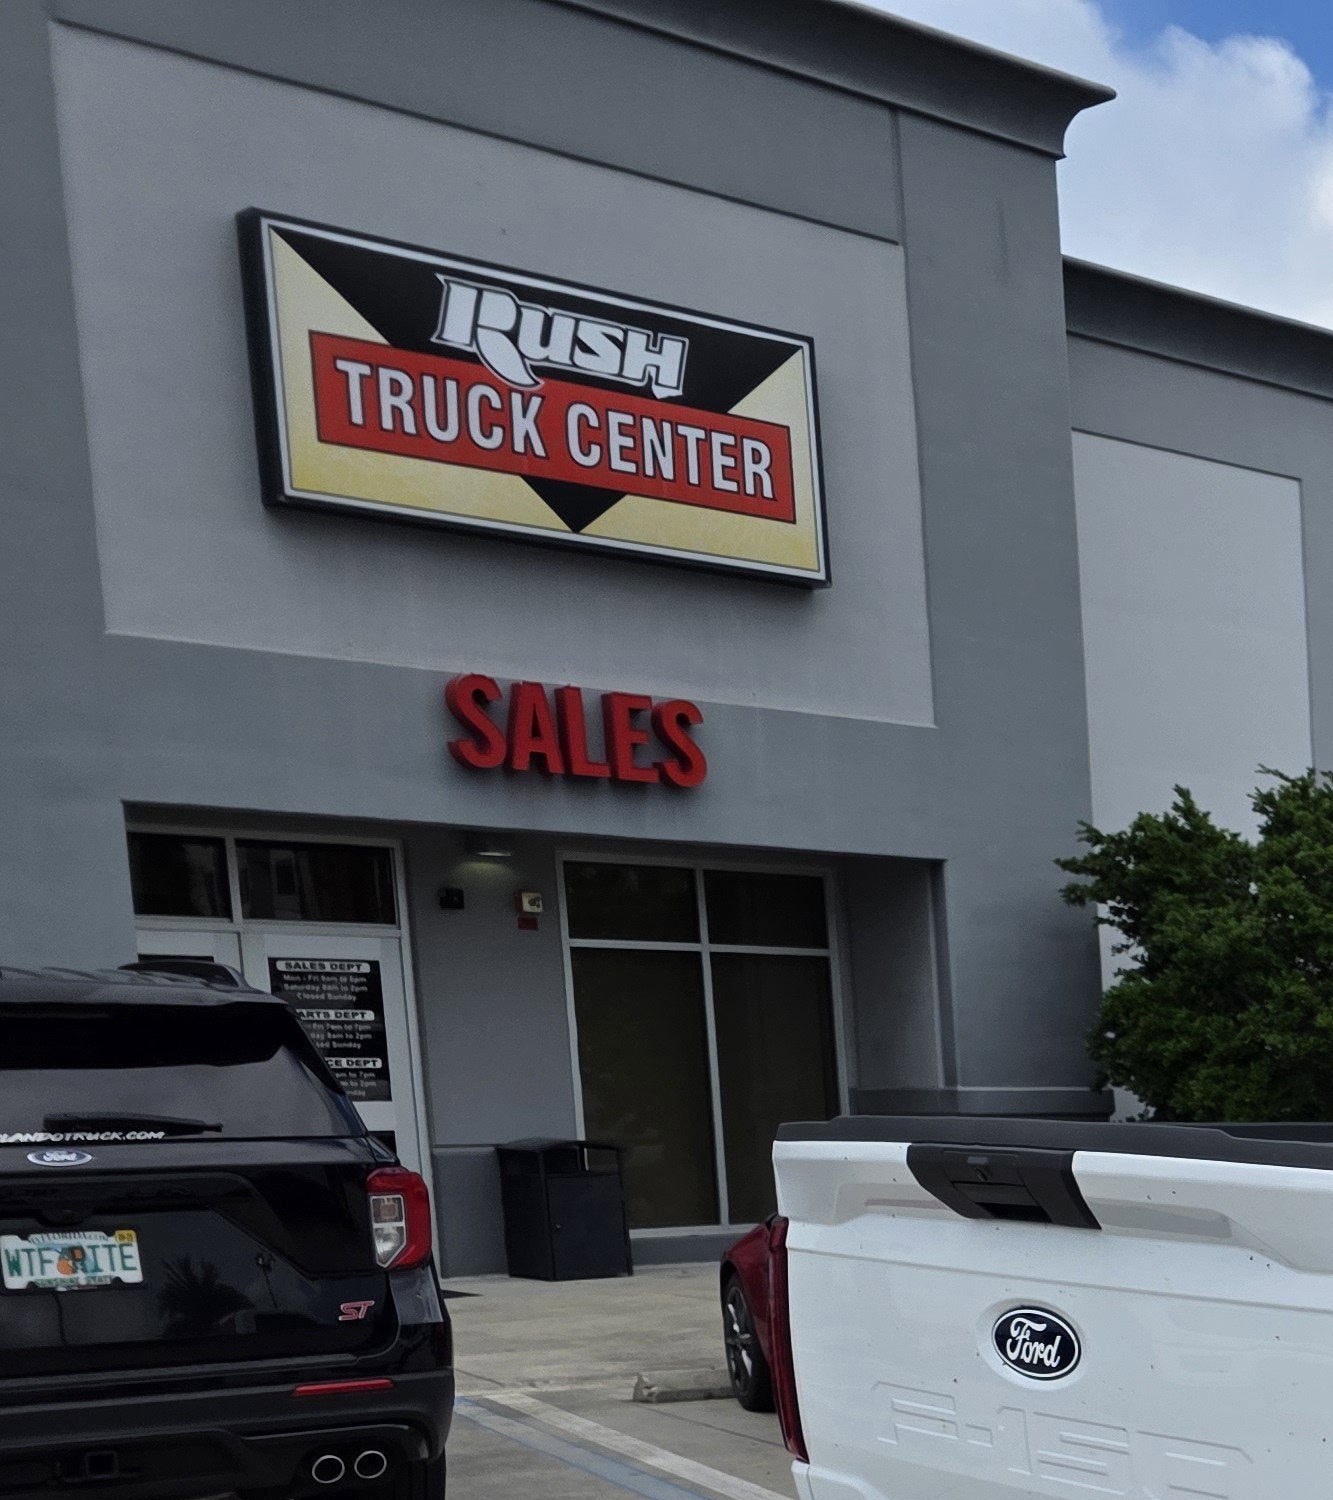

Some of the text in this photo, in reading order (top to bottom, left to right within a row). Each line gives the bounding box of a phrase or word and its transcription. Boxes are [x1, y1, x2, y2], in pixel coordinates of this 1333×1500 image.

[434, 273, 688, 399] RUSH
[335, 359, 775, 500] TRUCK CENTER
[445, 674, 708, 788] SALES
[284, 961, 363, 971] SALES DEPT
[298, 1010, 367, 1019] ARTS DEPT
[345, 1059, 379, 1067] DEPT
[0, 1131, 165, 1144] LANDOTRUCK.COM
[337, 1300, 376, 1322] ST
[1006, 1317, 1061, 1368] Ford
